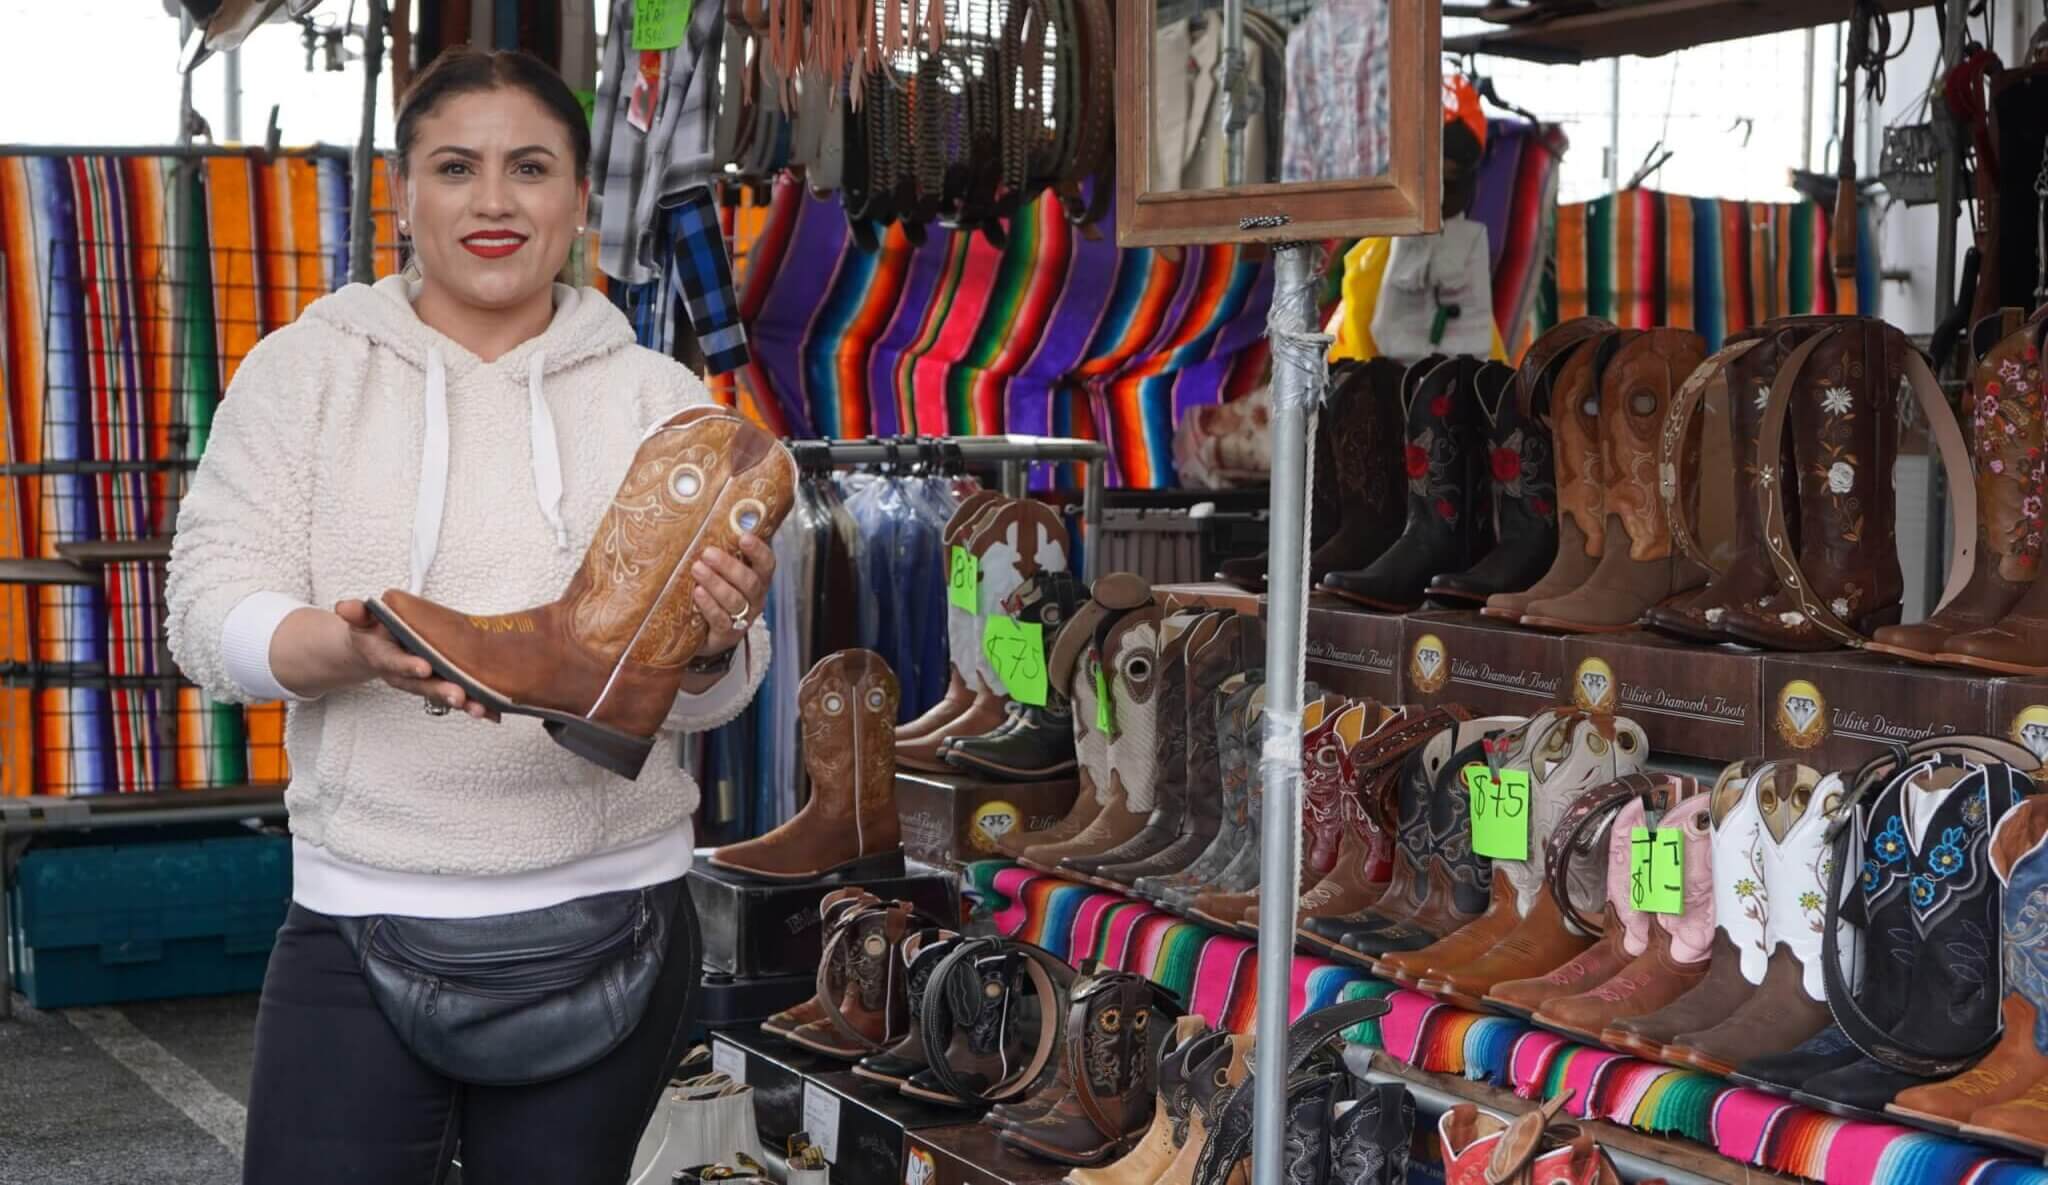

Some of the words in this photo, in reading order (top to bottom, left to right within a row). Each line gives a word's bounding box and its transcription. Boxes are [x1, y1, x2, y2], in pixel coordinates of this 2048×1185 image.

[986, 635, 1040, 680] $75
[1451, 657, 1478, 677] White
[1480, 663, 1526, 686] Diamonds
[1621, 682, 1652, 704] White
[1656, 688, 1708, 713] Diamonds
[1711, 697, 1746, 718] Boots
[1832, 708, 1869, 731] White
[1473, 775, 1526, 821] $75
